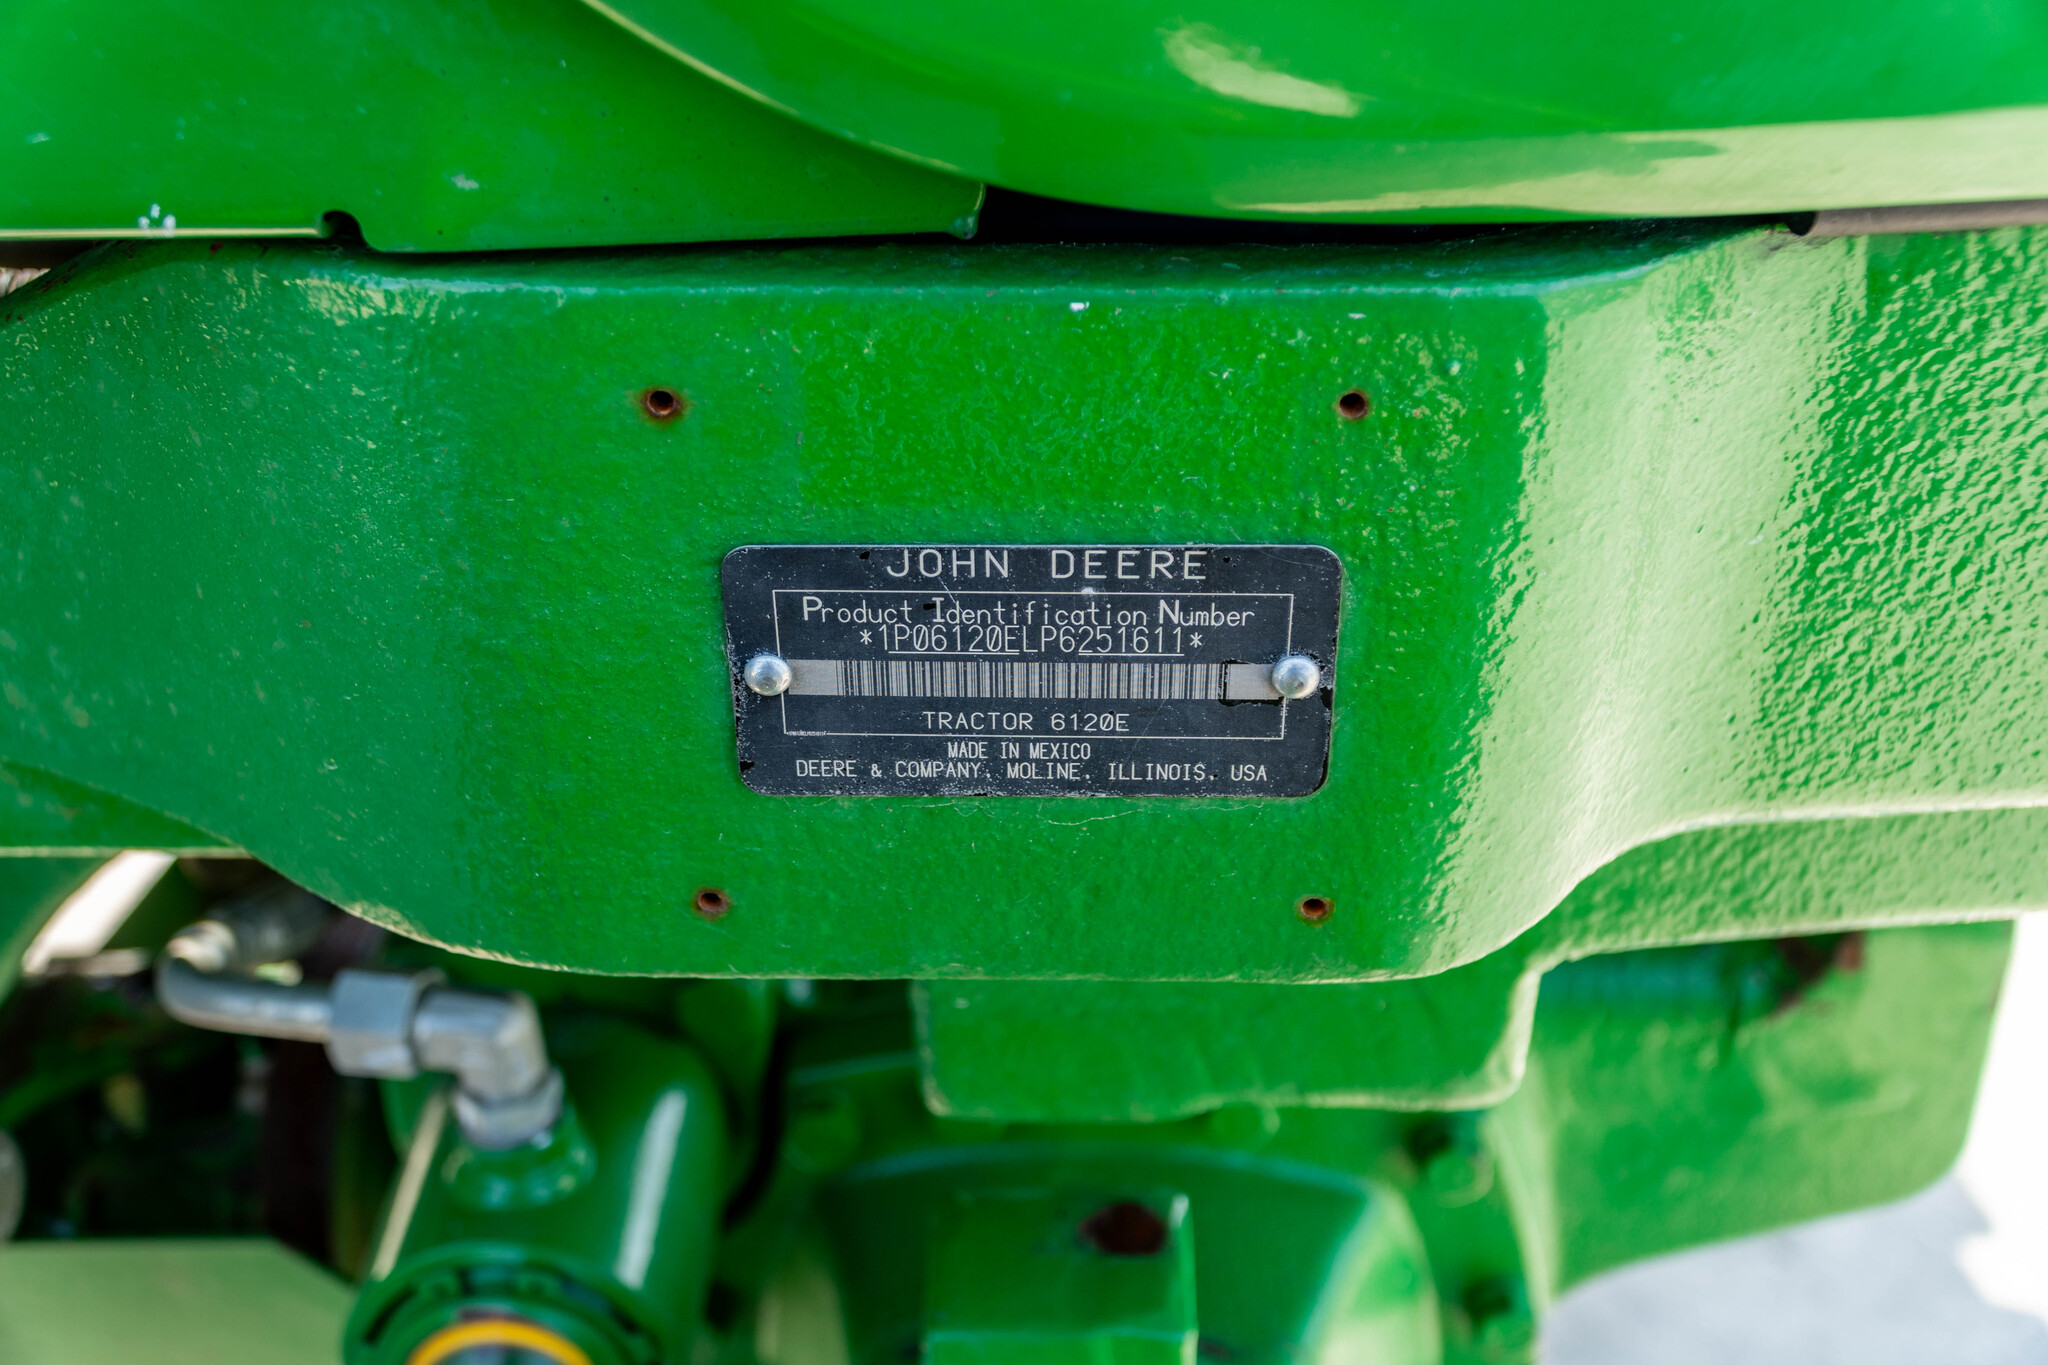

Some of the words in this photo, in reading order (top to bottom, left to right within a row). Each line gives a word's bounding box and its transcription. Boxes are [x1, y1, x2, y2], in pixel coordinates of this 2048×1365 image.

[886, 549, 1010, 578] JOHN
[1051, 550, 1208, 580] DEERE
[802, 596, 913, 624] Product
[932, 597, 1148, 627] Identification
[1158, 599, 1256, 627] Number
[923, 711, 1034, 731] TRACTOR
[1051, 713, 1130, 732] 6120E
[947, 741, 989, 760] MADE
[1000, 742, 1020, 760] IN
[1029, 742, 1091, 760] MEXICO
[796, 760, 858, 778] DEERE
[871, 763, 882, 778] &
[1231, 764, 1268, 782] USA
